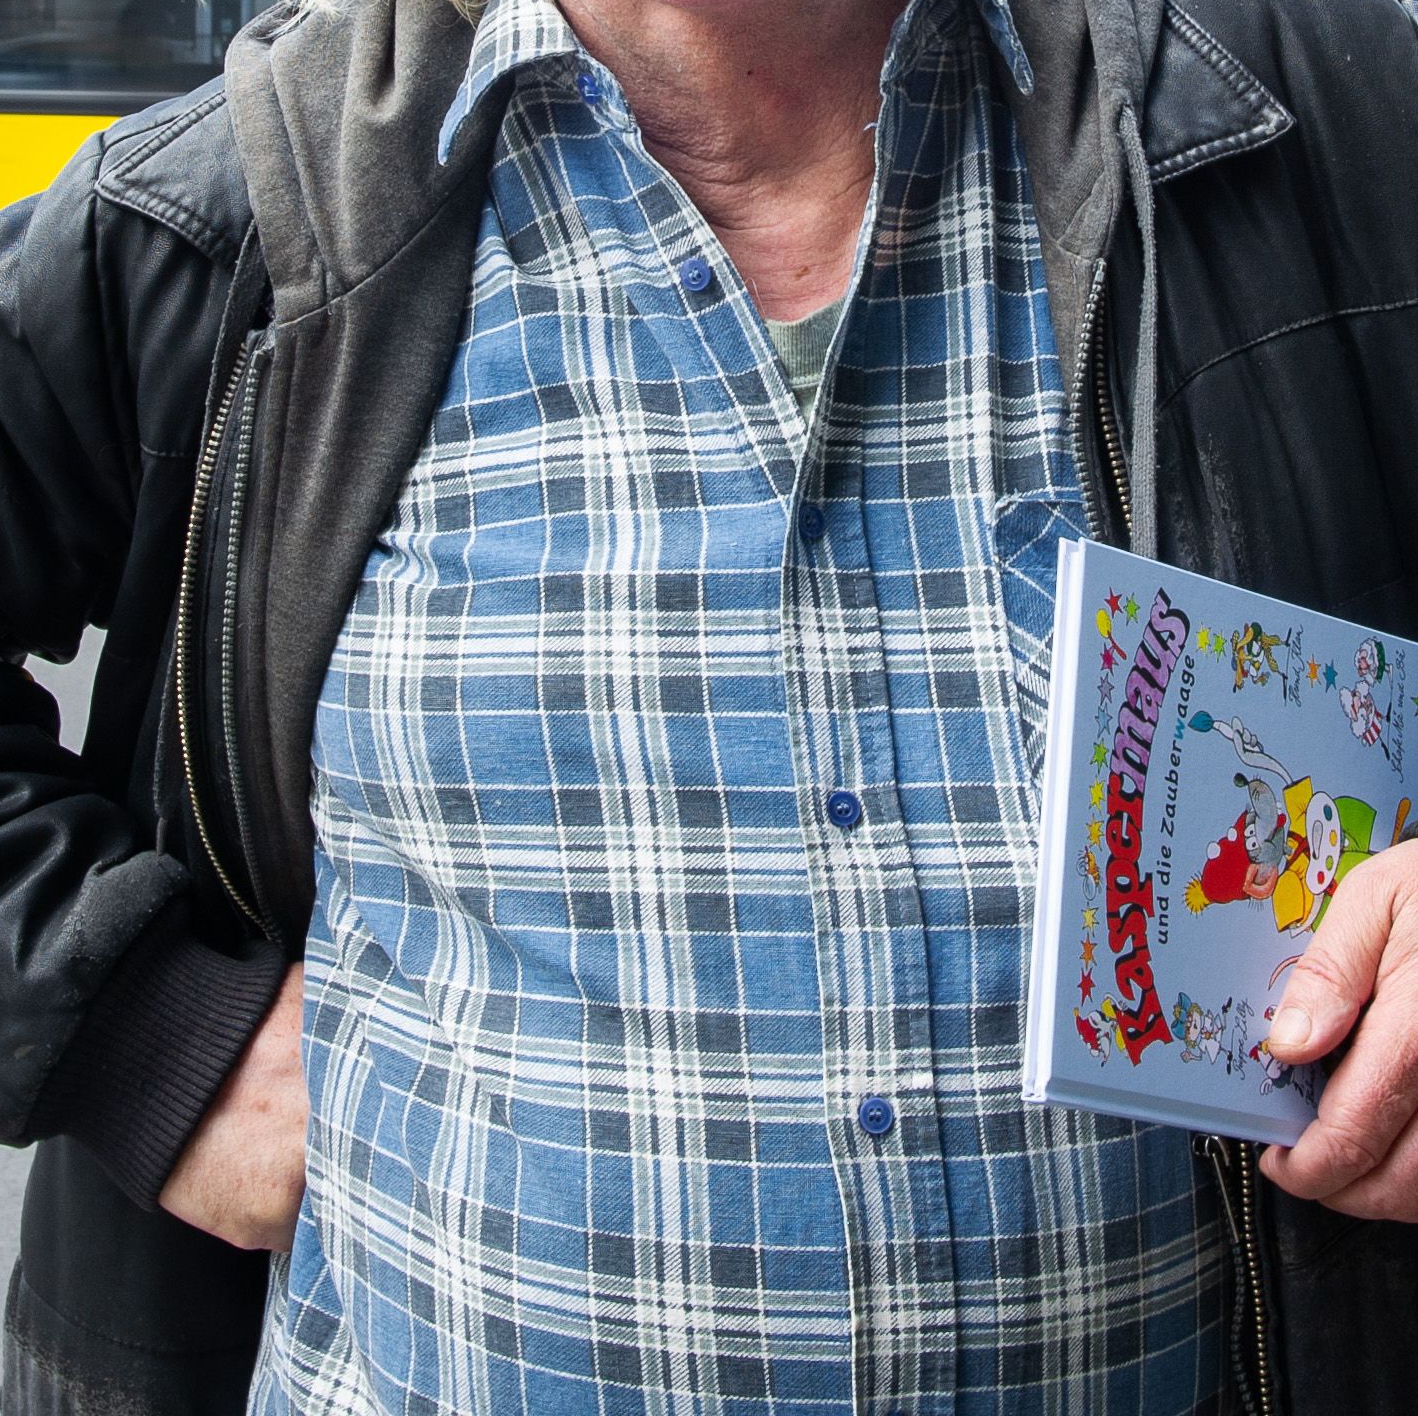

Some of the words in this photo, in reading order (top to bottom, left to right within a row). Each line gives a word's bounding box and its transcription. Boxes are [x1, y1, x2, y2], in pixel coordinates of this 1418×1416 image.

[1160, 654, 1196, 839] Zauberwaage
[1156, 844, 1173, 887] die
[1157, 895, 1170, 945] und
